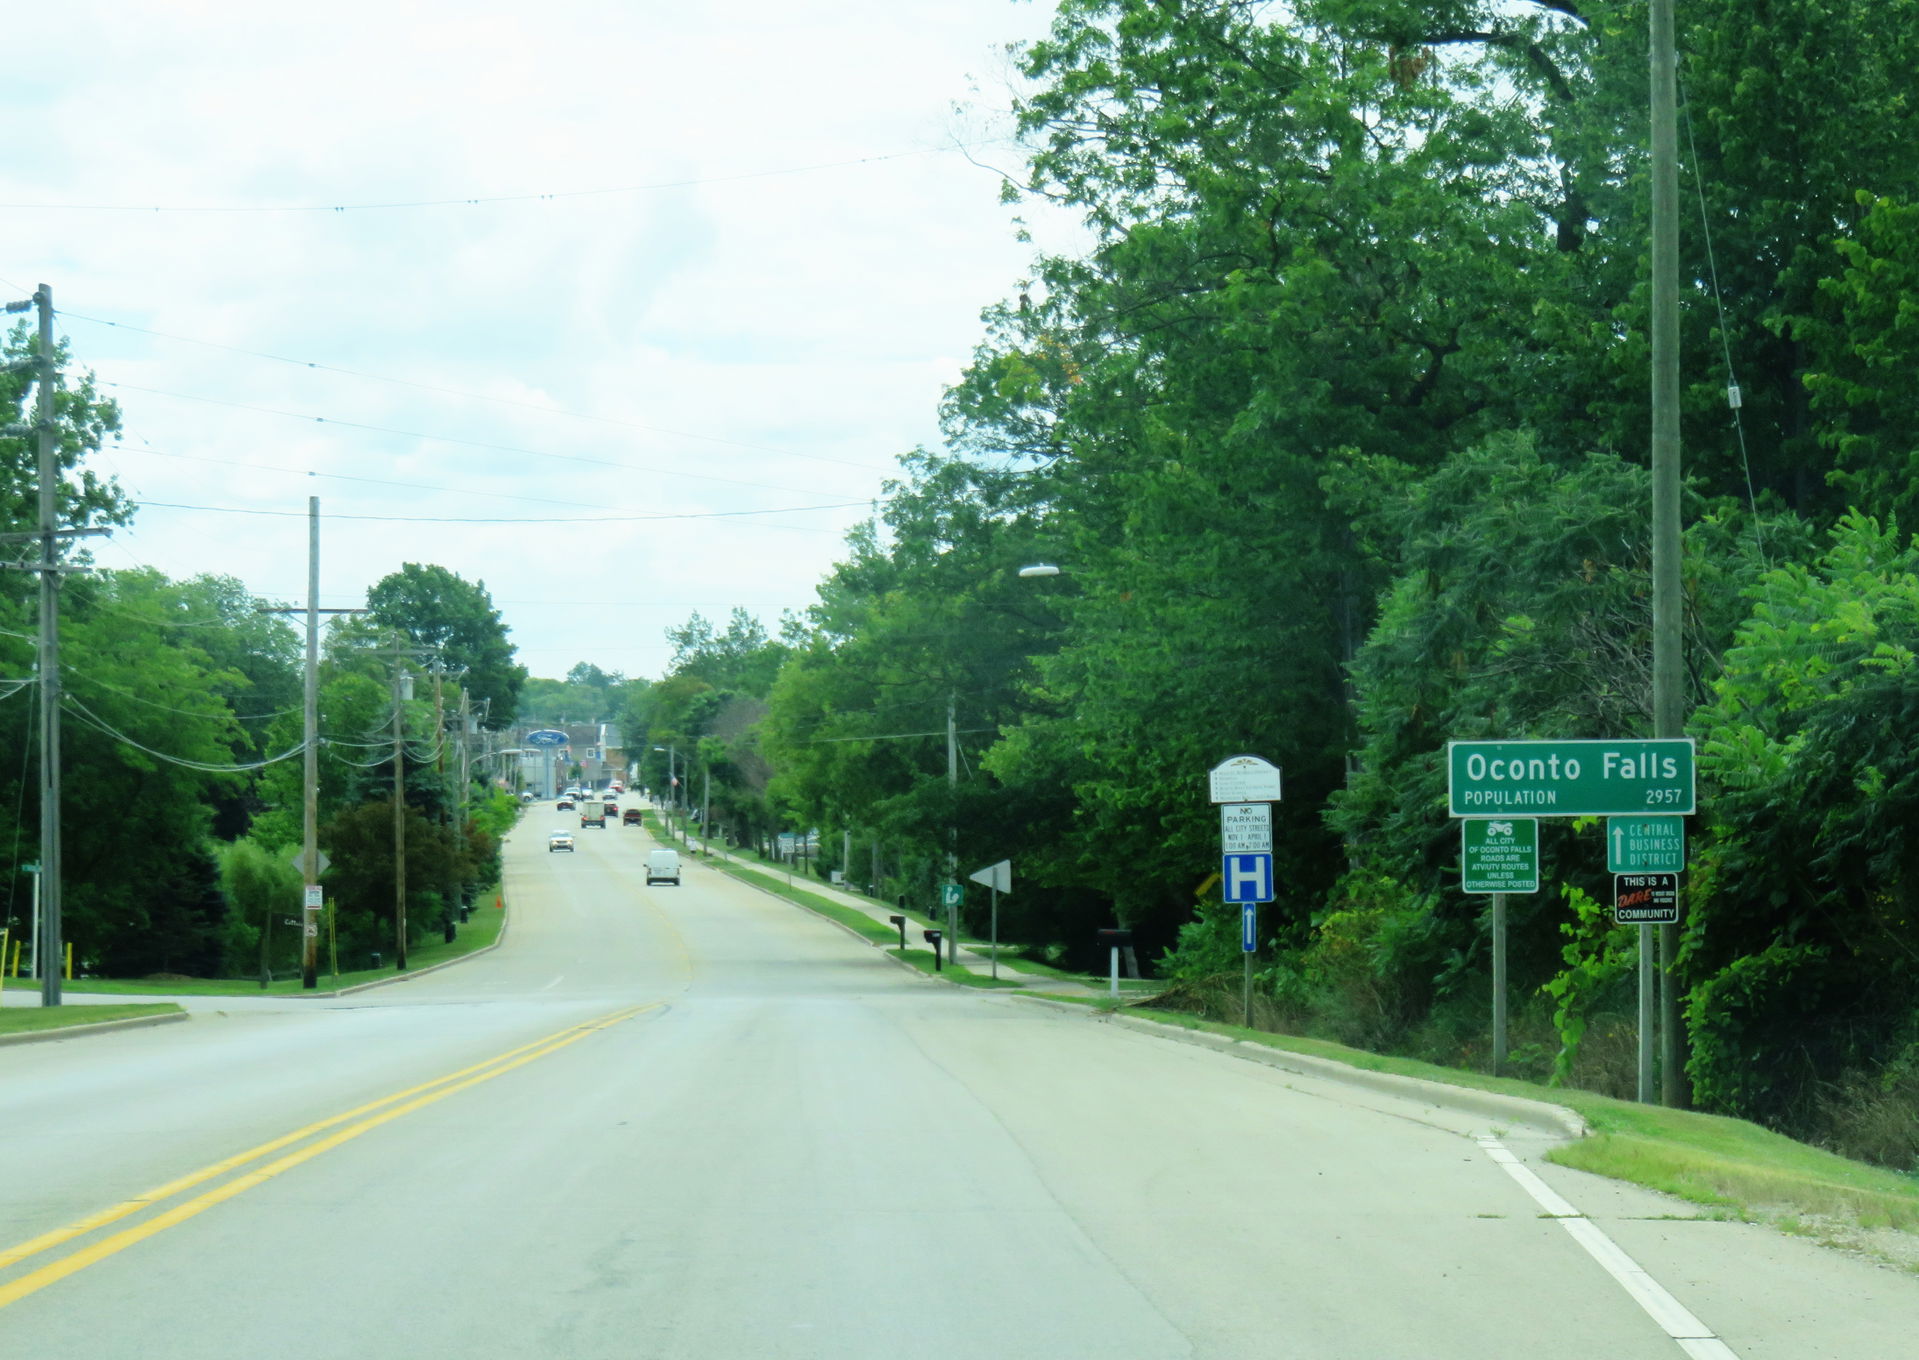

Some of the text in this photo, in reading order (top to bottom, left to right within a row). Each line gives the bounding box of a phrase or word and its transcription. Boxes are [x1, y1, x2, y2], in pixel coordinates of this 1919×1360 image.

[1467, 752, 1677, 781] Oconto Falls
[1465, 789, 1682, 805] POPULATION 2957
[1629, 824, 1675, 836] CENTRAL
[1630, 839, 1680, 850] BUSINESS
[1630, 853, 1676, 865] DISTRICT
[1231, 857, 1265, 899] H
[1624, 877, 1668, 886] THIS IS A
[1619, 909, 1674, 919] COMMUNITY
